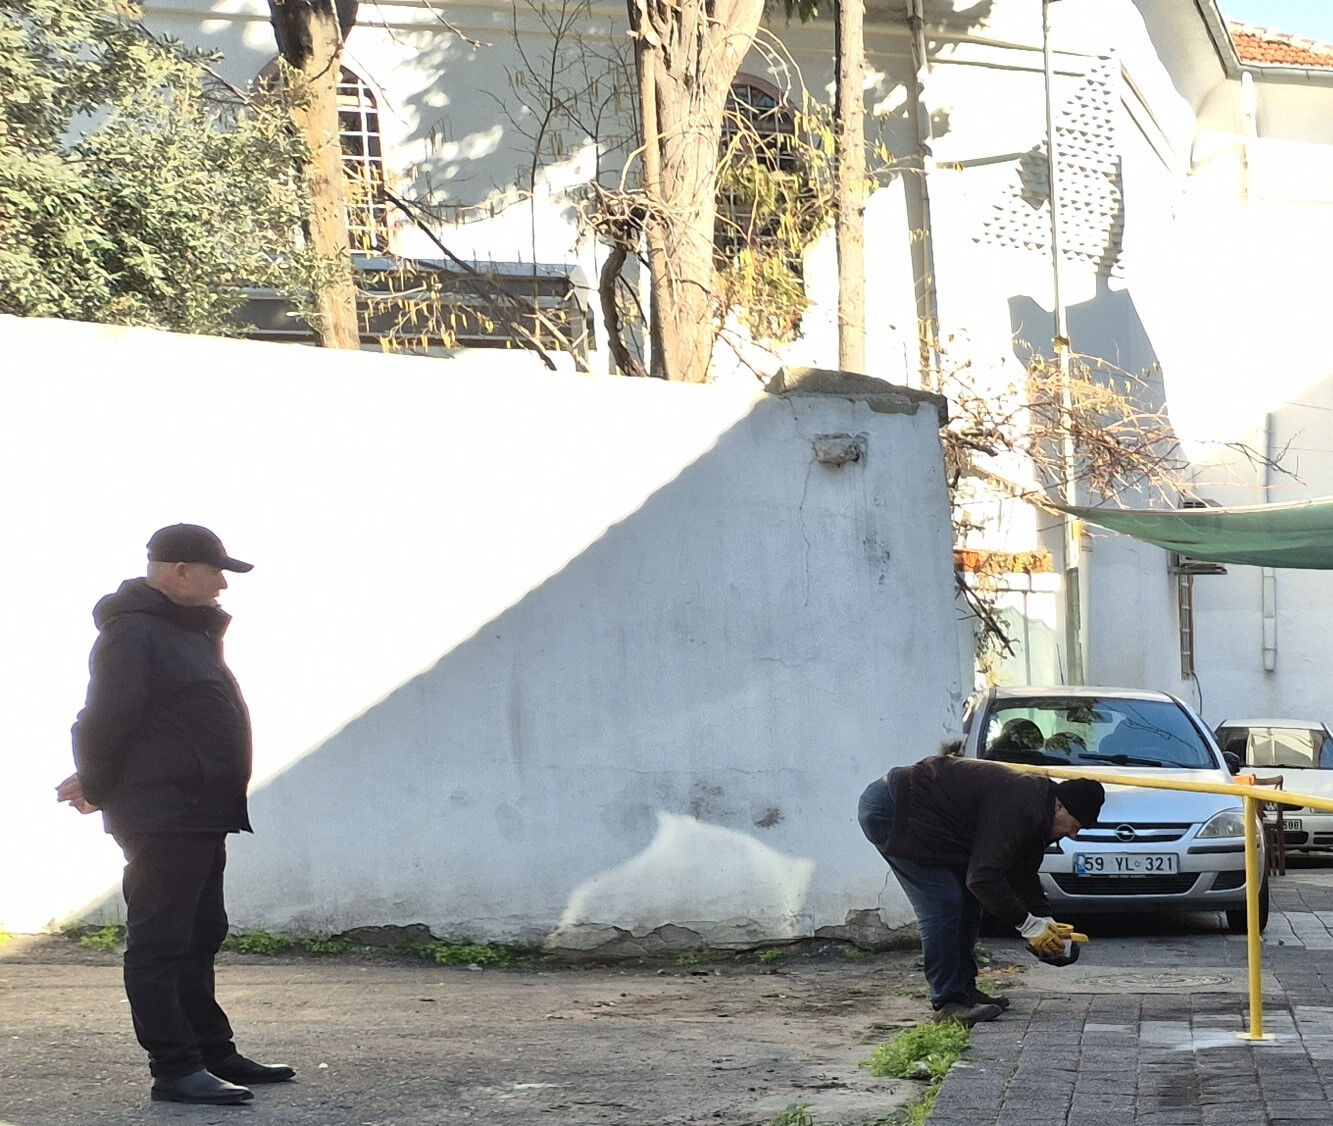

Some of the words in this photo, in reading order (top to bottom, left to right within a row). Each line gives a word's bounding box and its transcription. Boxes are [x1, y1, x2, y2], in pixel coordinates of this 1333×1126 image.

[1085, 857, 1104, 871] 59
[1115, 857, 1135, 871] YL
[1145, 857, 1172, 871] 321
